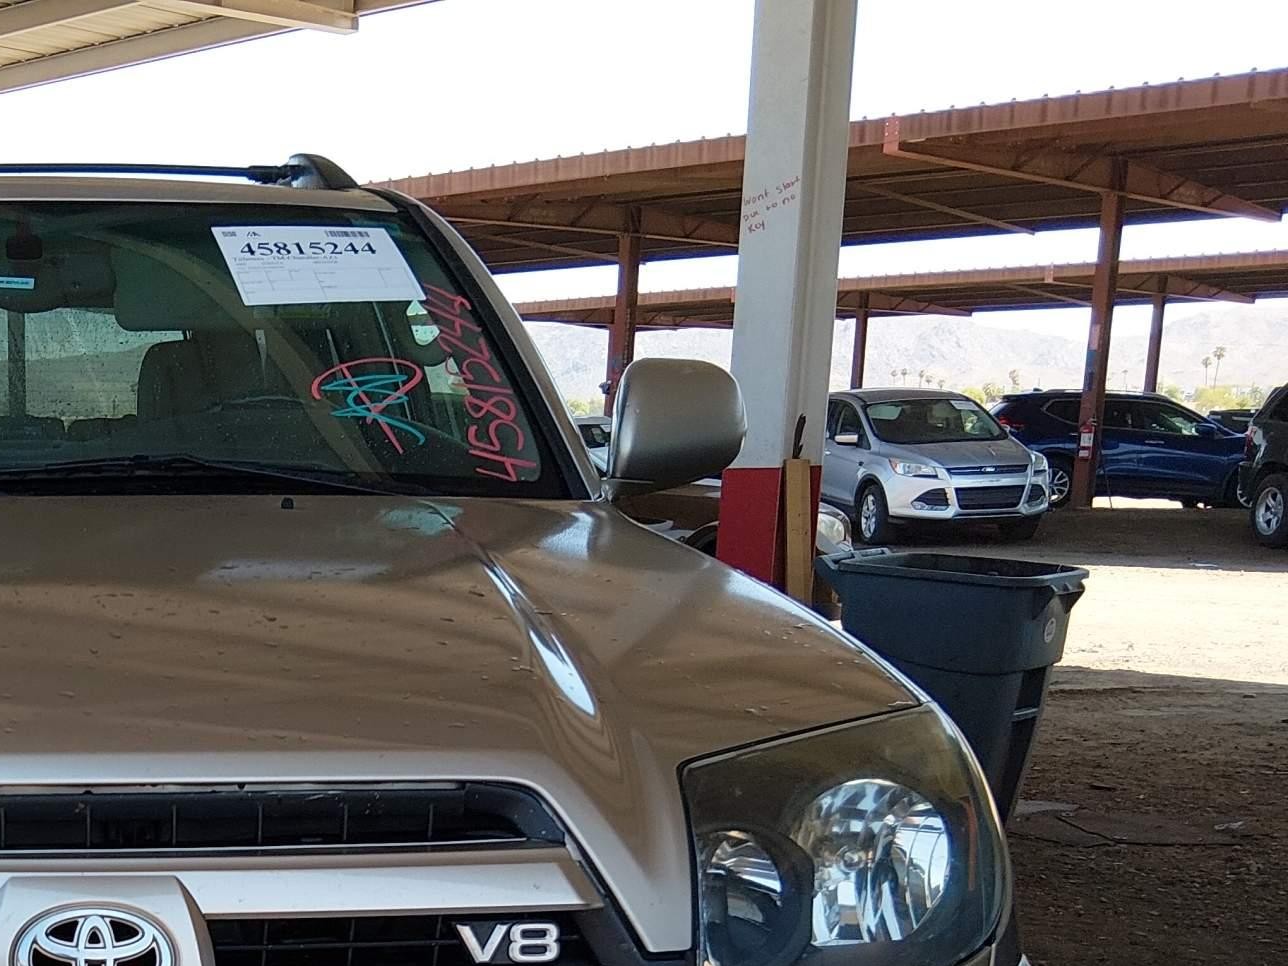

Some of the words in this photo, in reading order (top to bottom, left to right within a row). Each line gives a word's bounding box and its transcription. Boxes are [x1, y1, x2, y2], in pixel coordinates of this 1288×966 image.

[240, 241, 377, 257] 45815244
[423, 283, 537, 482] 45815244
[455, 922, 561, 964] V8
